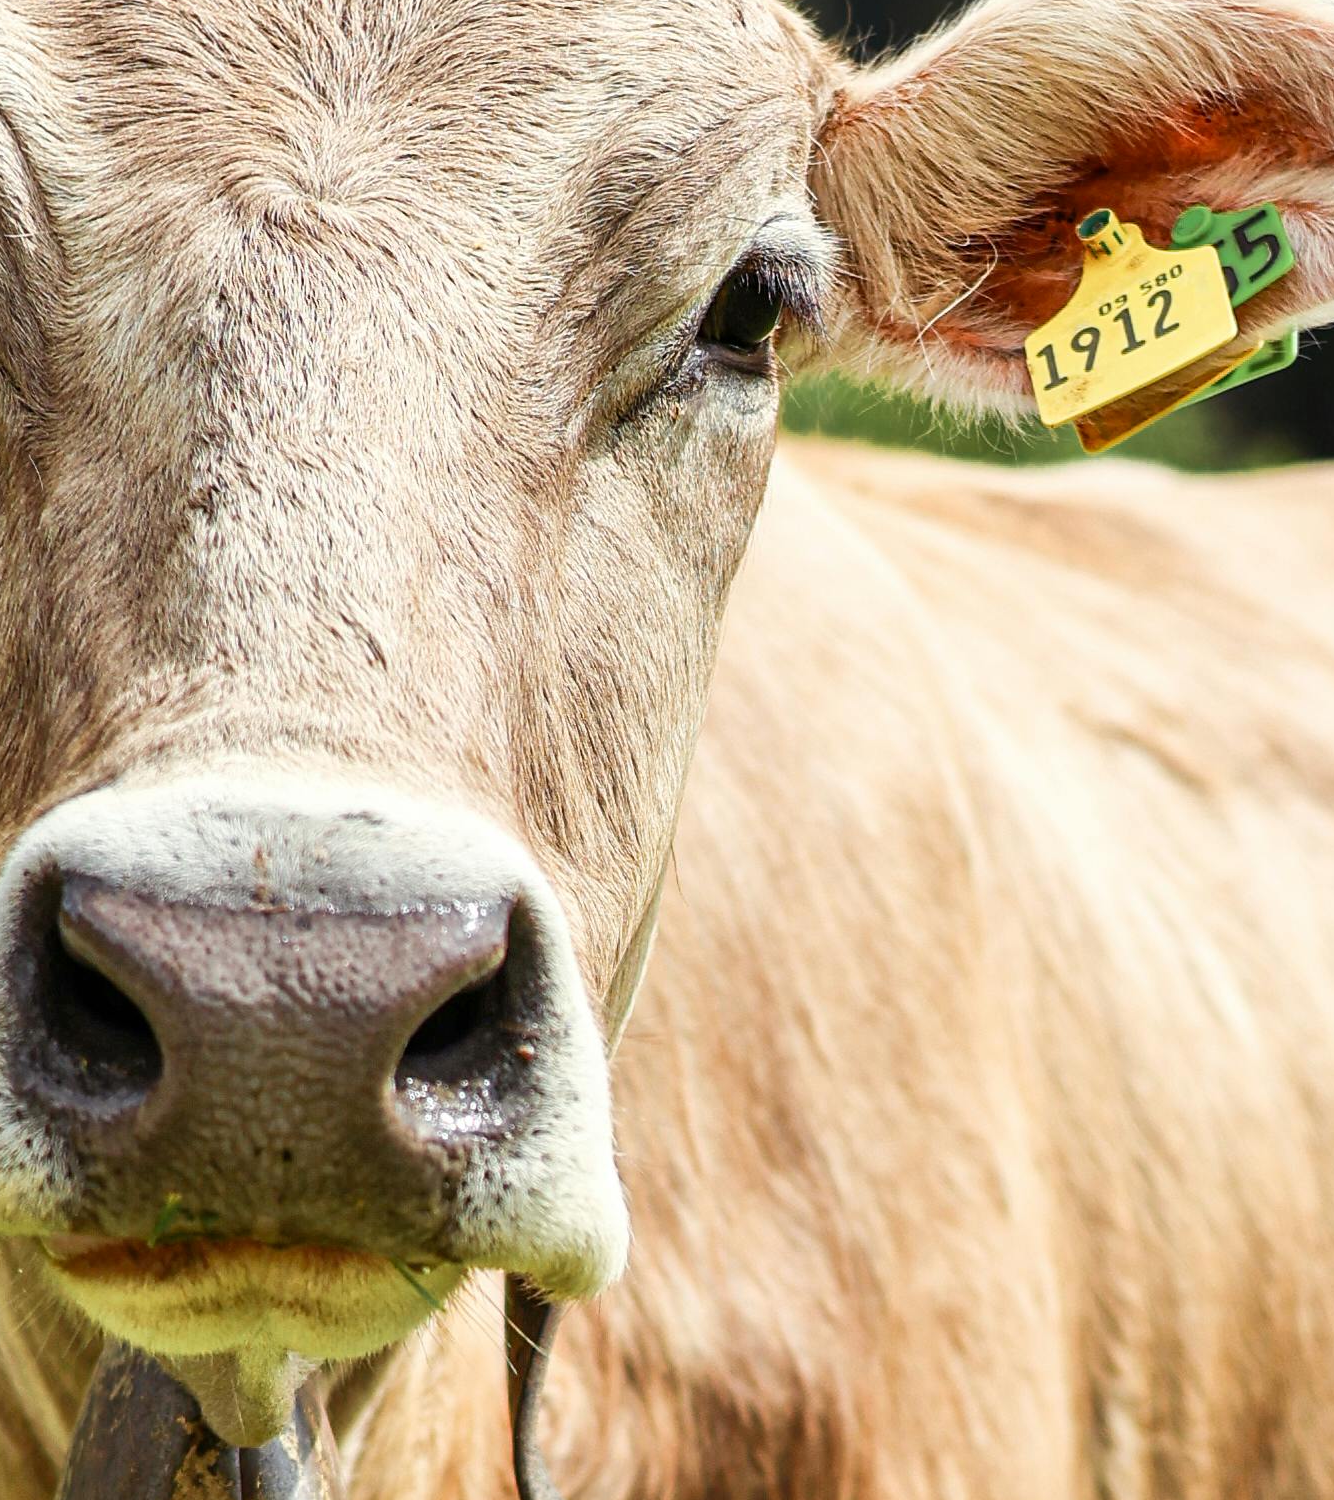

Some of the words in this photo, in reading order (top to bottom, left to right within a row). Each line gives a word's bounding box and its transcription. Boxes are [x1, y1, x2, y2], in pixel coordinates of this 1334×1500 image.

[1098, 294, 1128, 316] 09
[1139, 264, 1183, 296] 580
[1036, 290, 1180, 390] 1912
